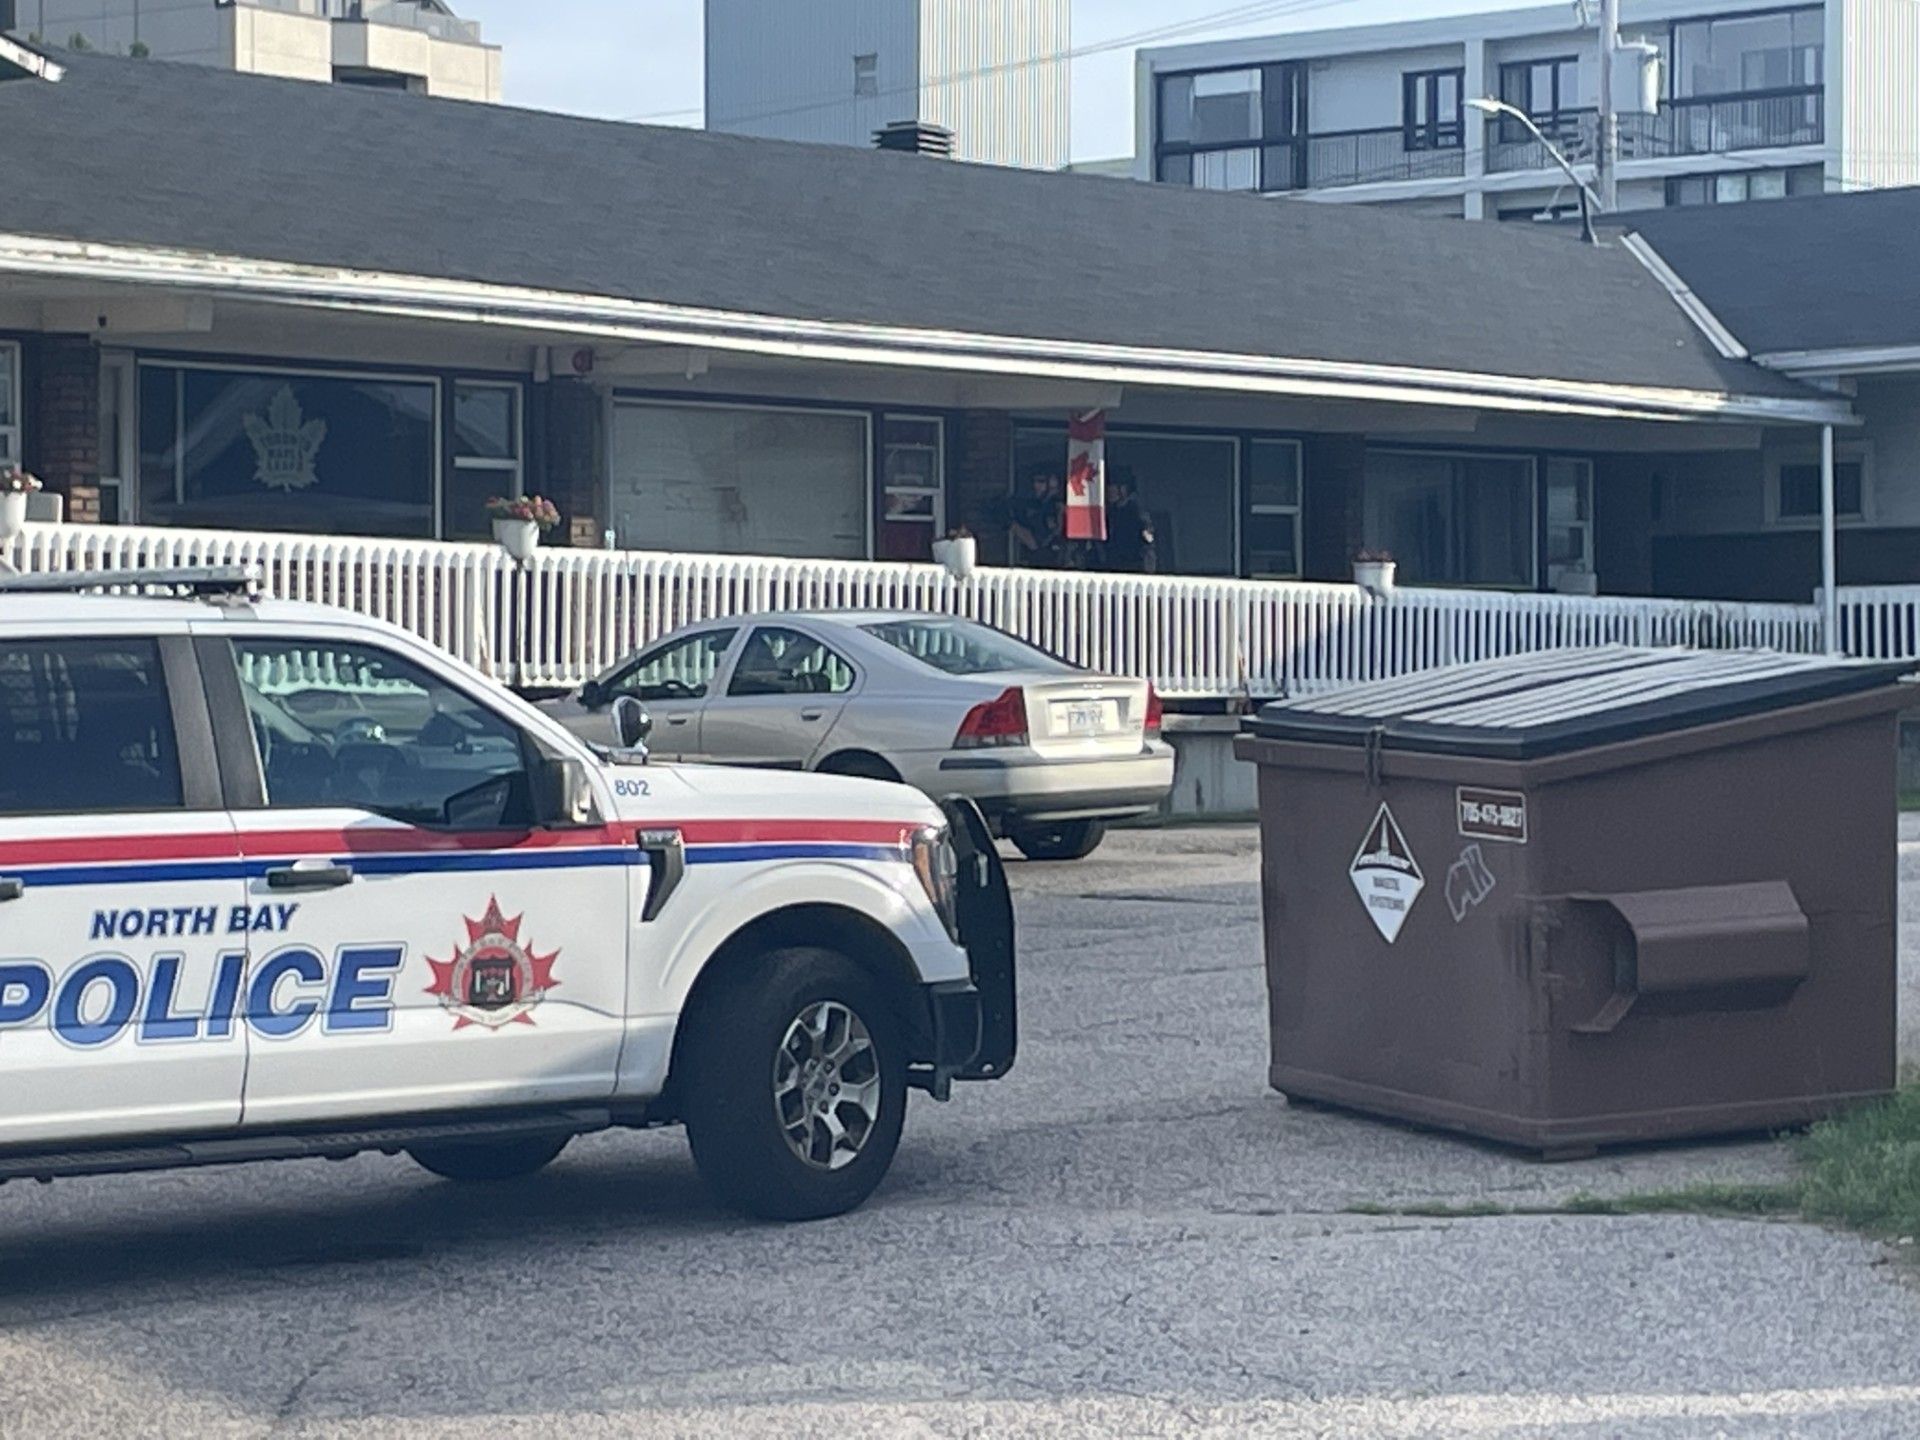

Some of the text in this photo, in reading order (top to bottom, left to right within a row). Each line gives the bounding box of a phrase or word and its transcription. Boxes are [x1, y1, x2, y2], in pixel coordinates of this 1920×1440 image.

[614, 779, 651, 796] 802
[91, 903, 298, 938] NORTH BAY
[0, 943, 405, 1048] POLICE
